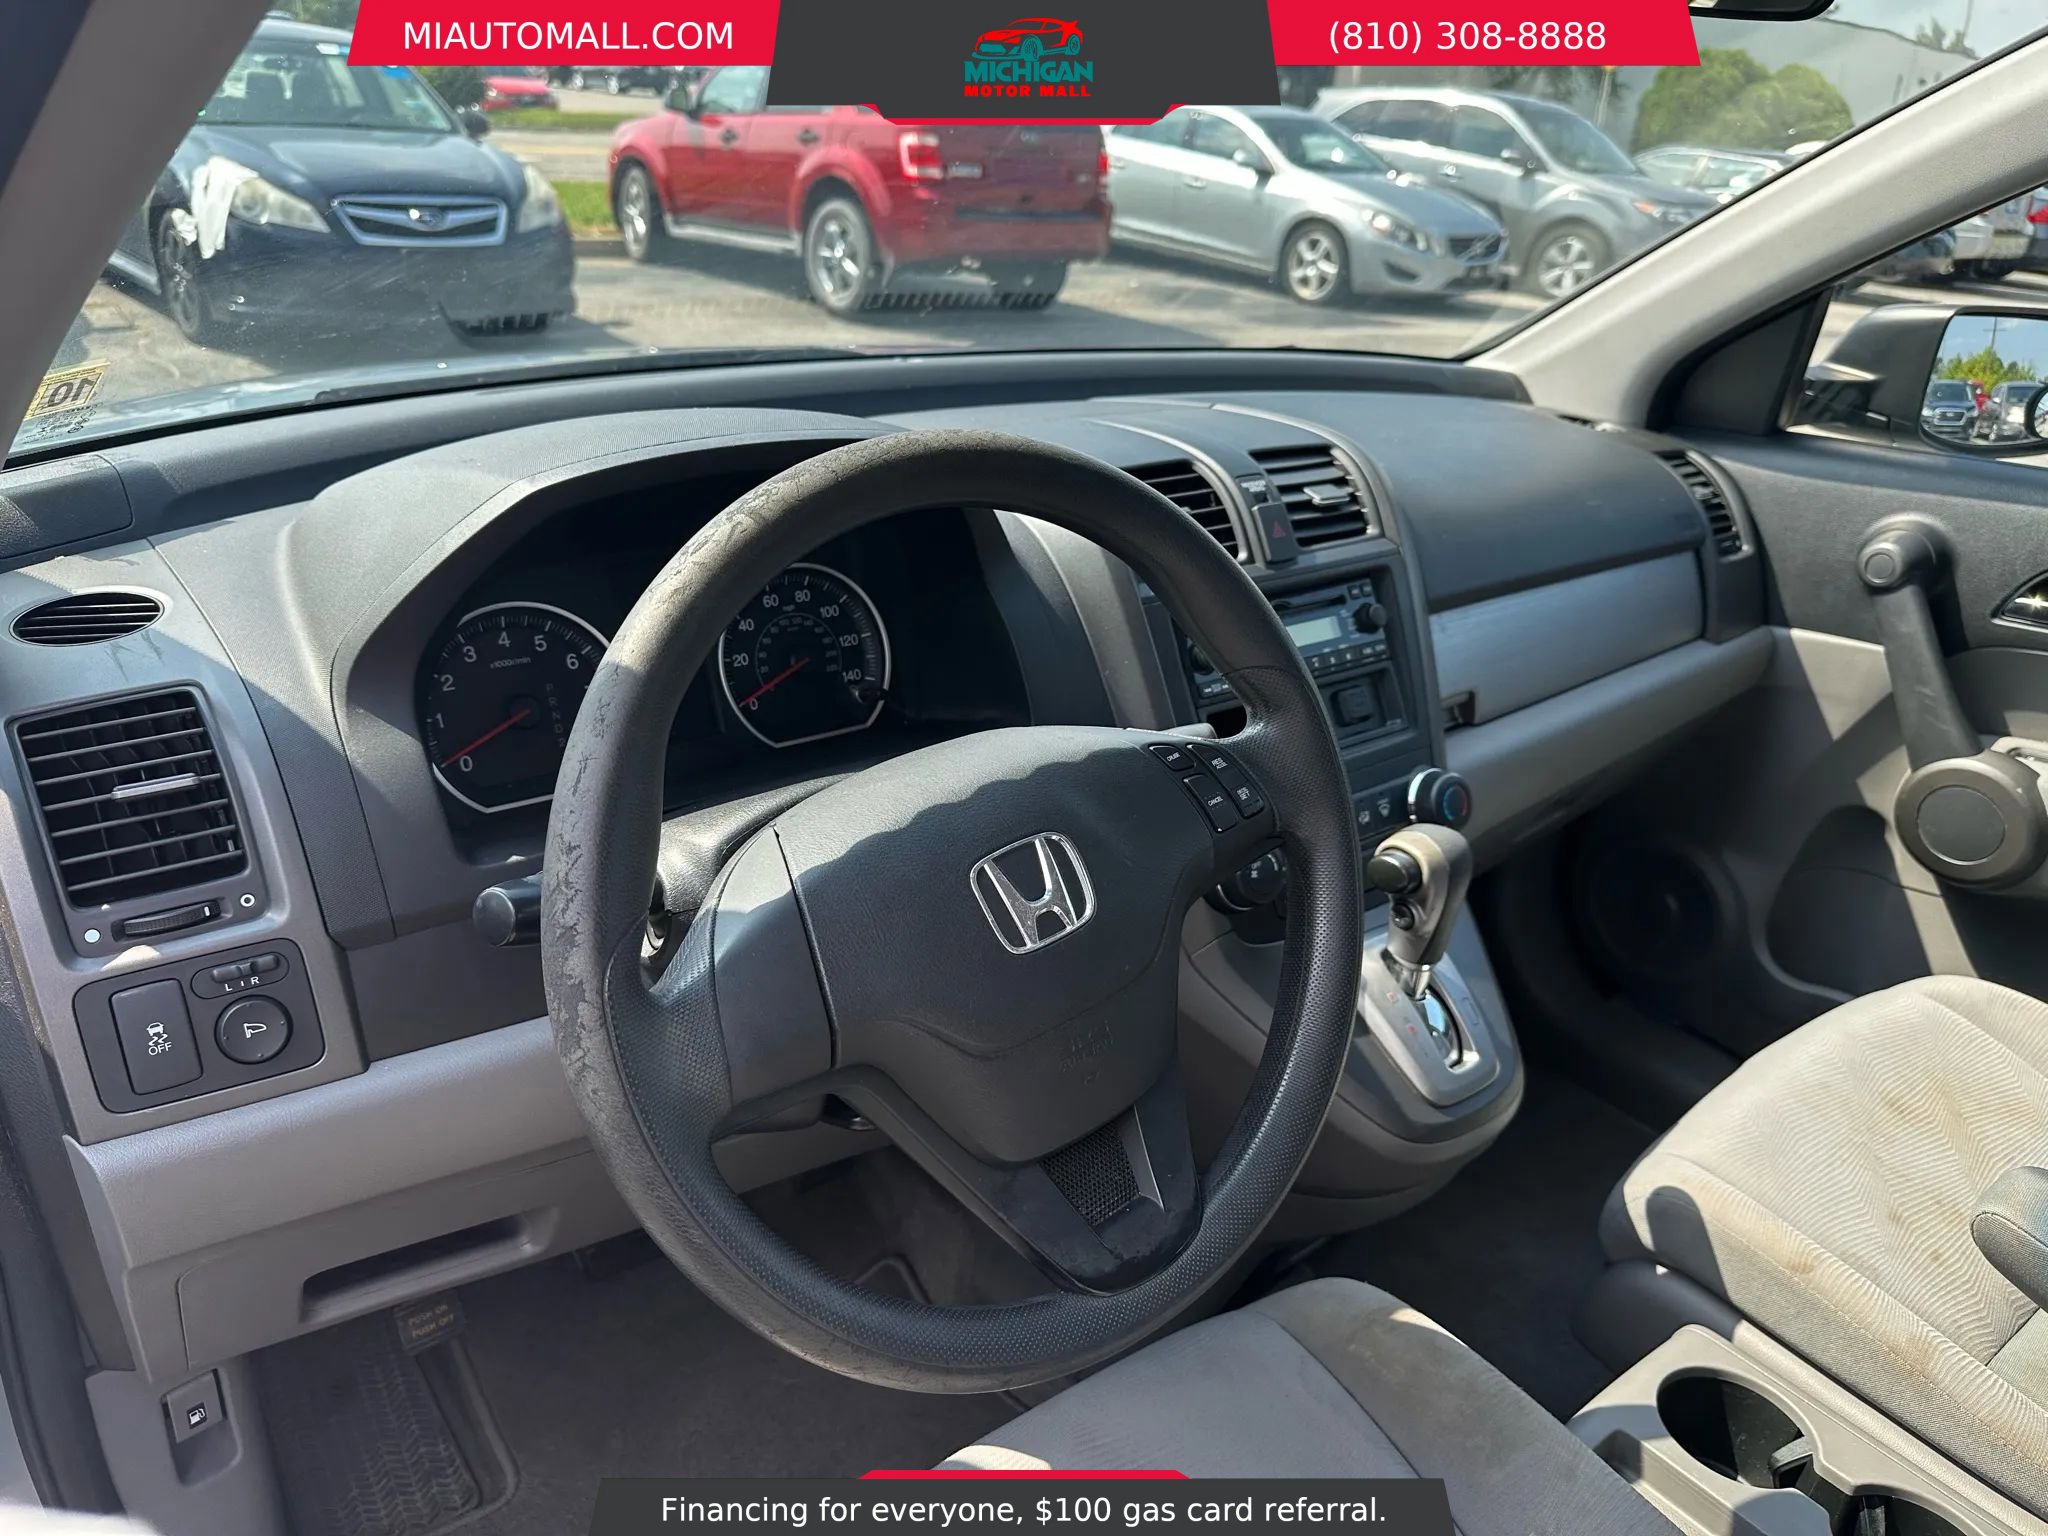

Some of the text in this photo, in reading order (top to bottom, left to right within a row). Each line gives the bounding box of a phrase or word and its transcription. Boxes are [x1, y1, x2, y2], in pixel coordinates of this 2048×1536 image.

[762, 594, 779, 608] 60
[794, 589, 811, 603] 80
[819, 604, 840, 619] 100
[738, 618, 755, 632] 40
[498, 631, 511, 648] 4
[533, 635, 547, 652] 5
[839, 633, 859, 647] 120
[463, 645, 477, 663] 3
[566, 653, 580, 670] 6
[732, 652, 749, 668] 20
[440, 674, 456, 692] 2
[842, 668, 862, 683] 140
[749, 697, 759, 711] 0
[436, 712, 444, 729] 1
[459, 755, 473, 772] 0
[224, 983, 233, 992] L
[250, 976, 260, 985] R
[148, 1041, 172, 1056] OFF
